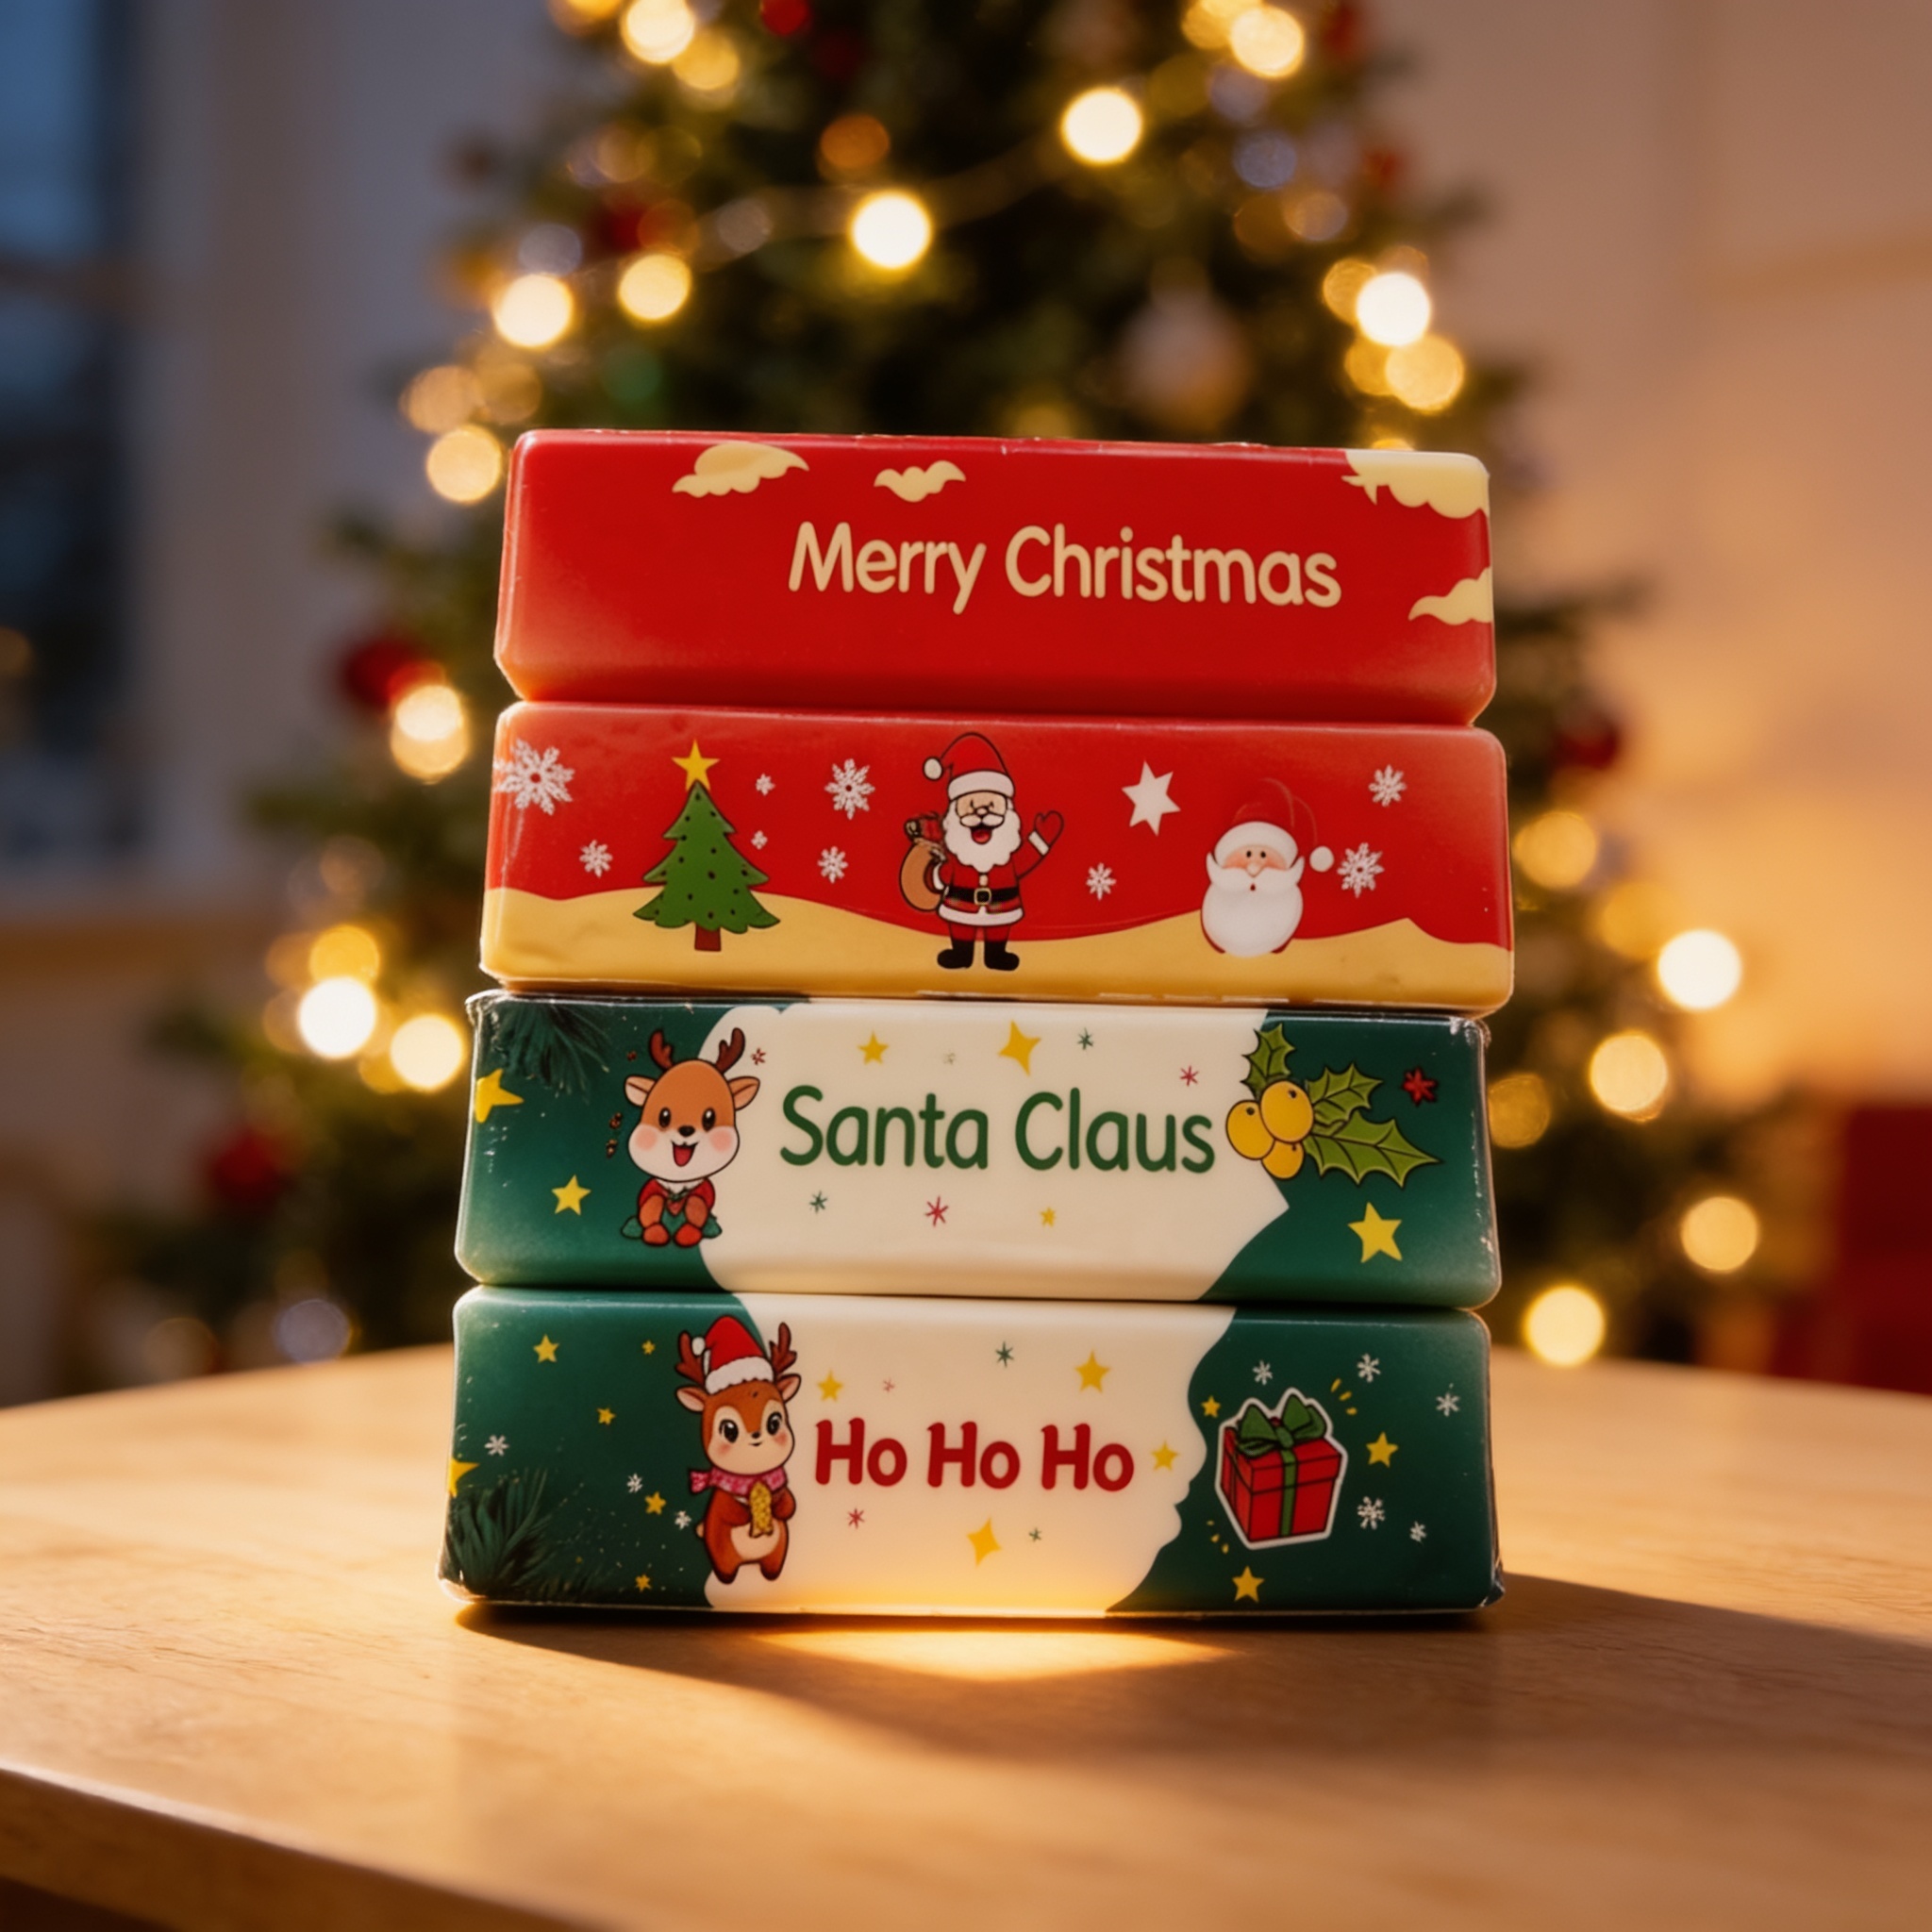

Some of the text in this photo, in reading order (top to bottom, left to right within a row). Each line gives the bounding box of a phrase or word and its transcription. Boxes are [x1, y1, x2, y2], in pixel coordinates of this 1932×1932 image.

[789, 522, 1341, 614] Merry Christmas
[779, 1084, 1216, 1174] Santa Claus
[814, 1416, 1135, 1493] Ho Ho Ho
